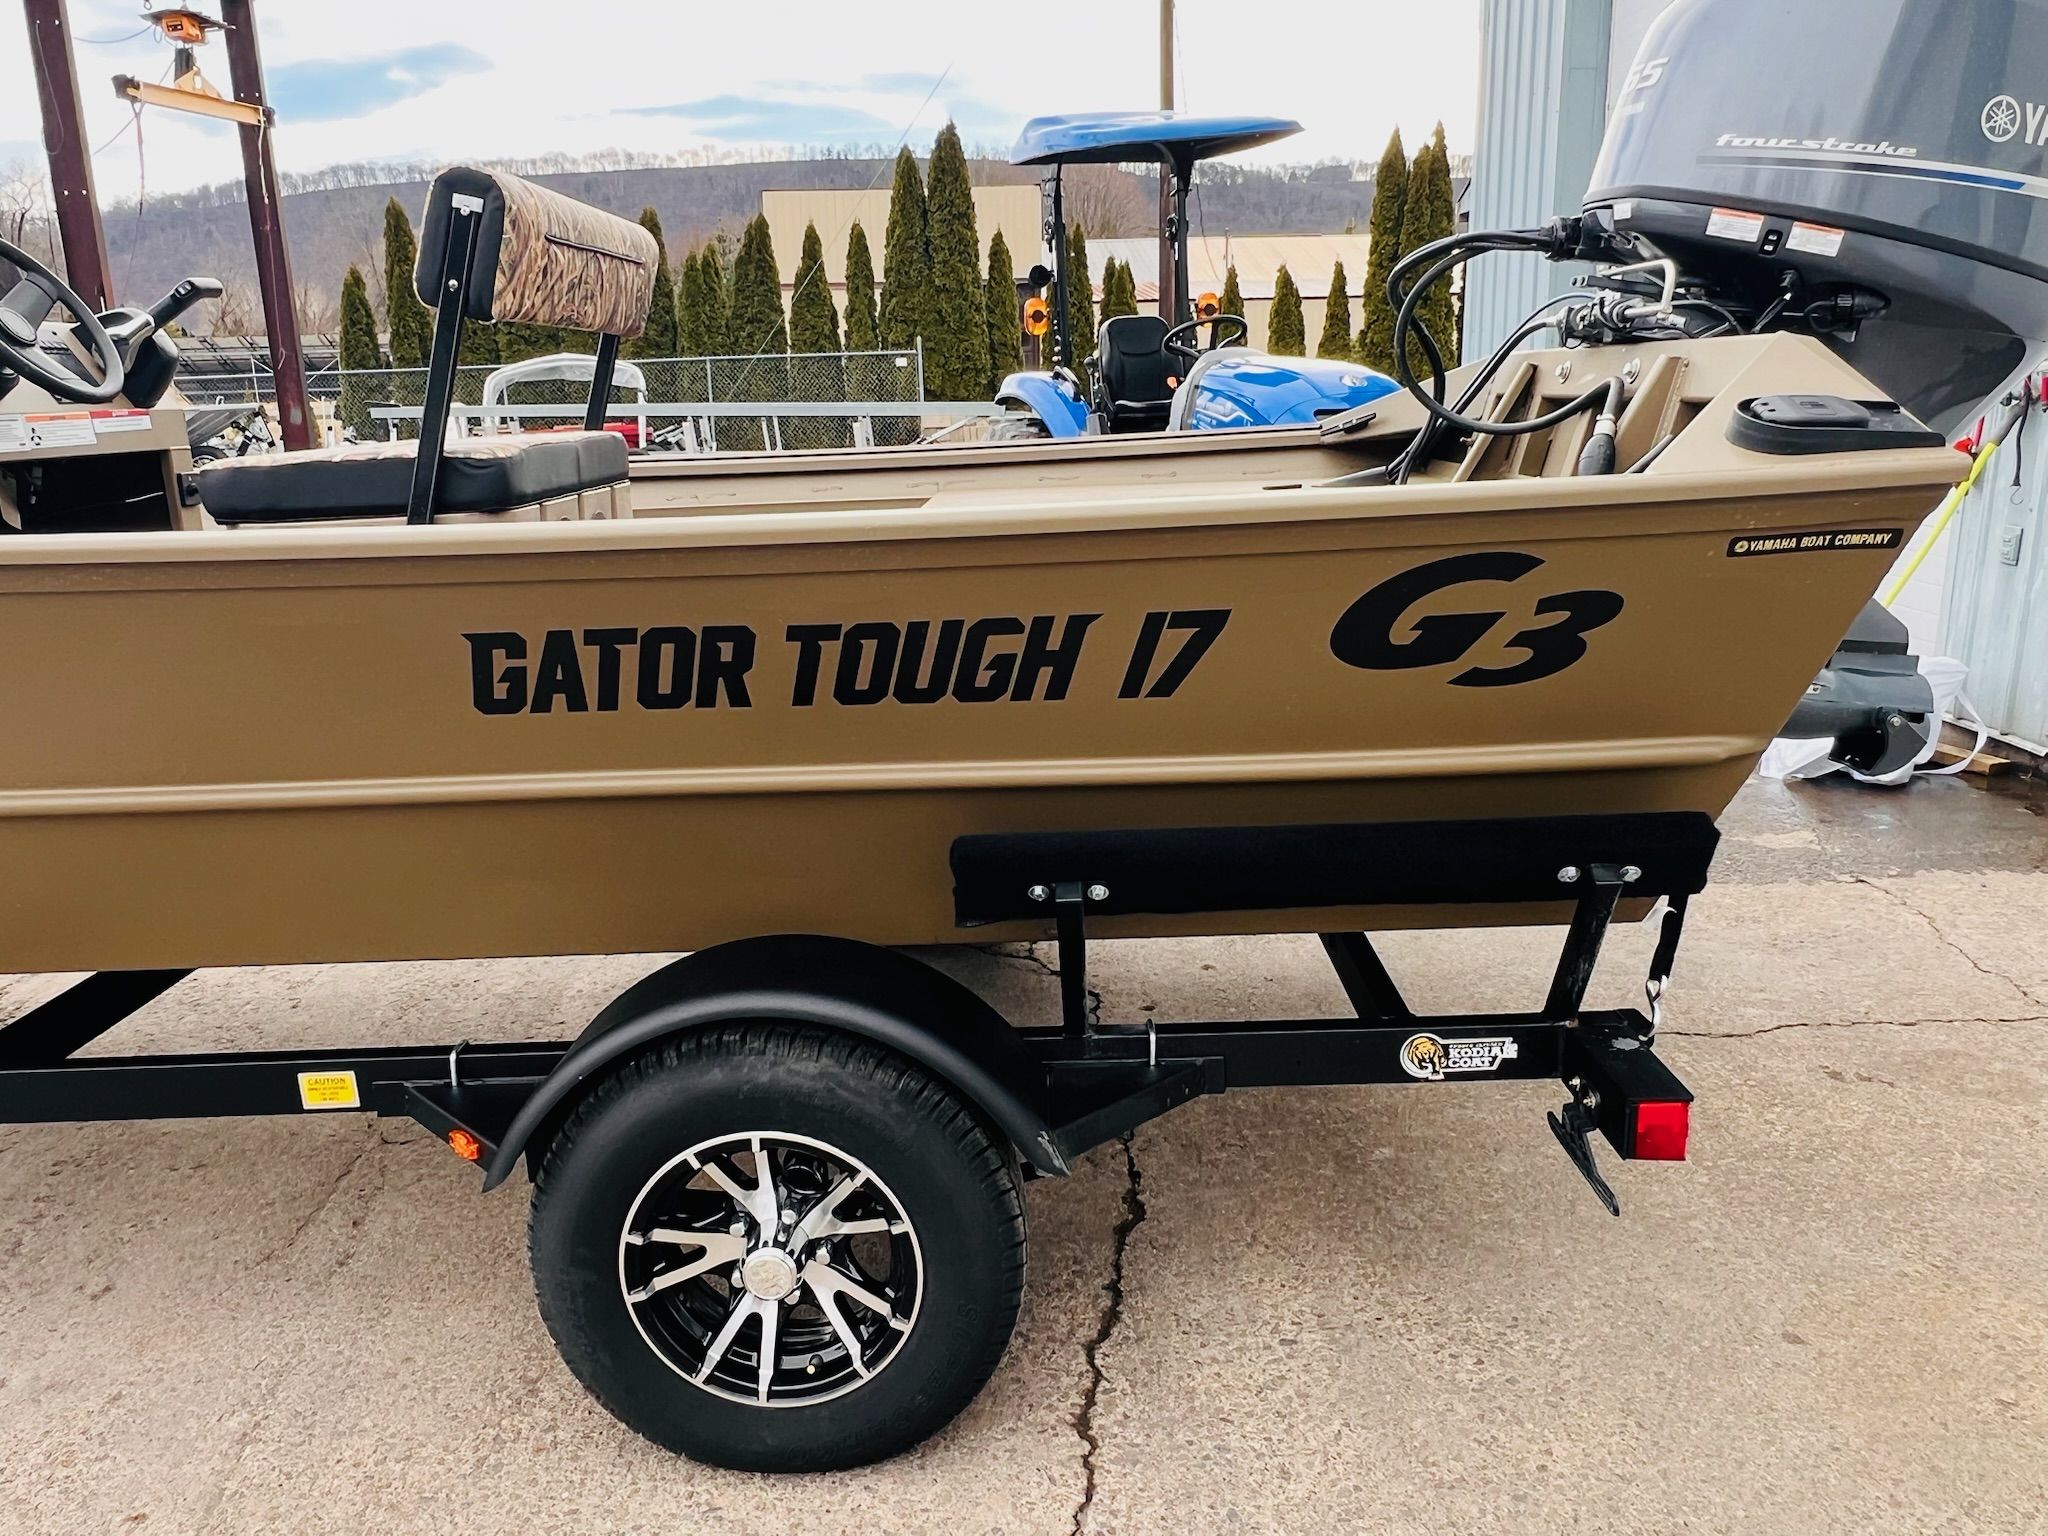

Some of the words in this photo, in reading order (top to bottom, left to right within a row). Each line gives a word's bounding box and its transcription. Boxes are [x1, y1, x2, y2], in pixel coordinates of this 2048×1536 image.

[1750, 537, 1797, 551] YAMAHA
[1800, 535, 1831, 548] BOAT
[1834, 533, 1892, 546] COMPANY
[1330, 551, 1625, 687] G3
[460, 625, 757, 715] GATOR
[785, 613, 1105, 707] TOUGH
[1117, 608, 1232, 699] 17
[1447, 1057, 1492, 1068] COAT
[307, 1077, 346, 1086] CAUTION
